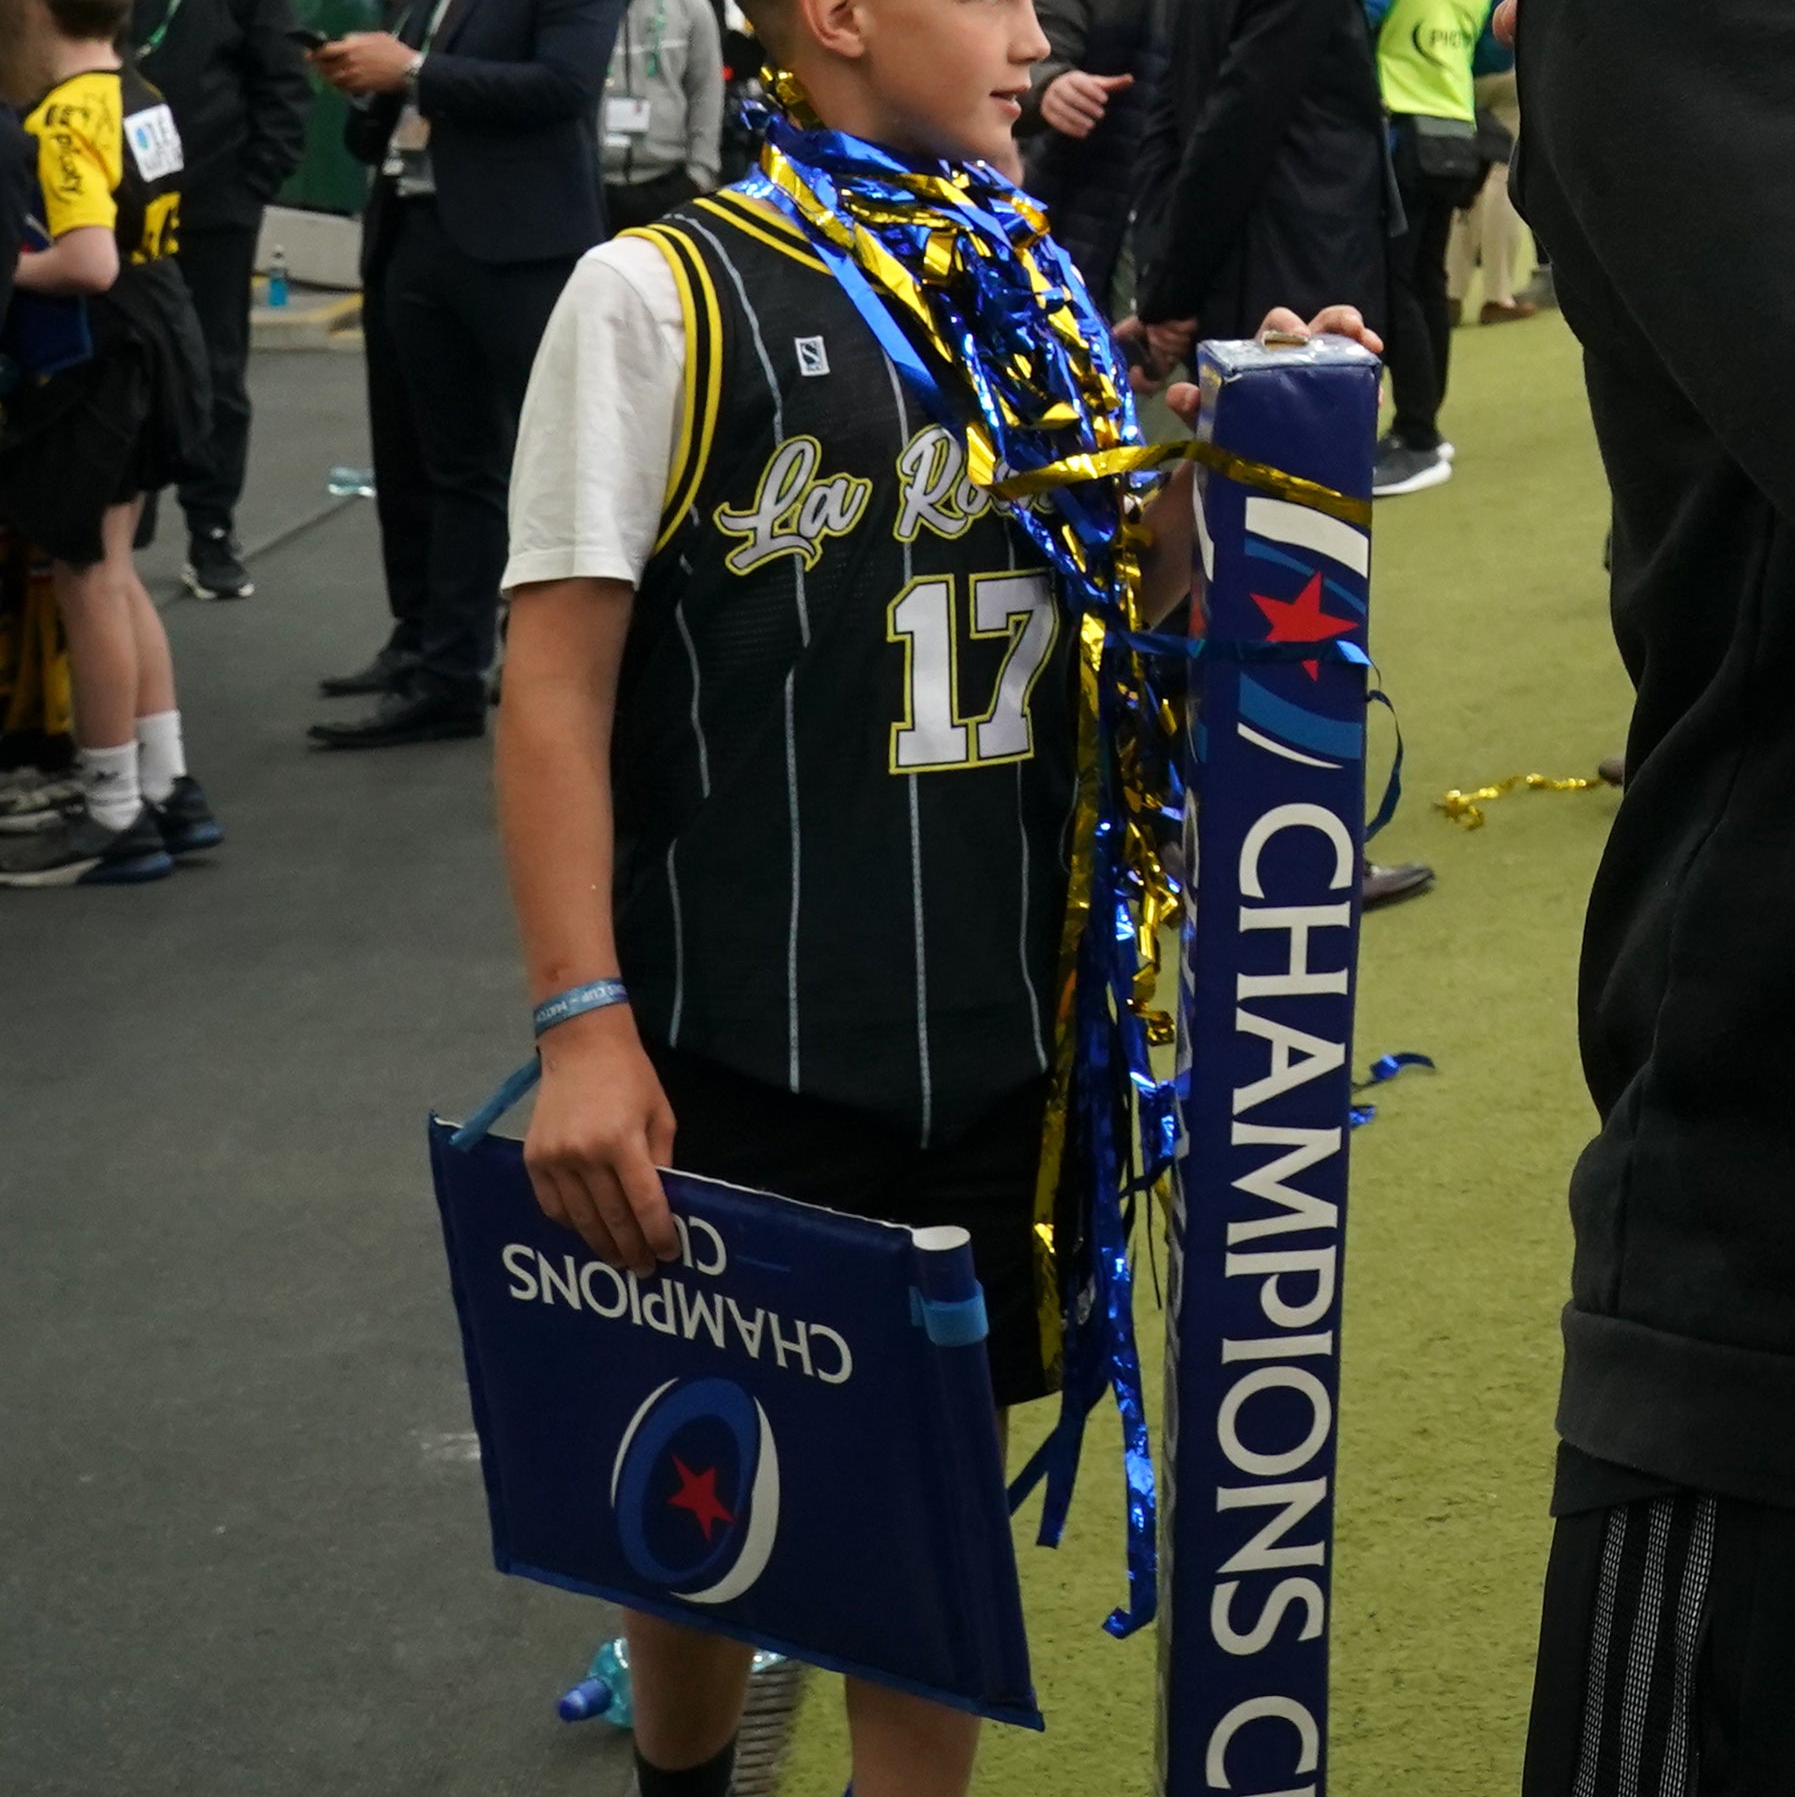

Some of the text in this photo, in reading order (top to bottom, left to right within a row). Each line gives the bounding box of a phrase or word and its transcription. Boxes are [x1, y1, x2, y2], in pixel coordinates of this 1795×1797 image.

[712, 433, 873, 576] La
[887, 567, 1060, 775] 17
[501, 1242, 854, 1385] CHAMPIONS
[1204, 803, 1355, 1797] CHAMPIONS C
